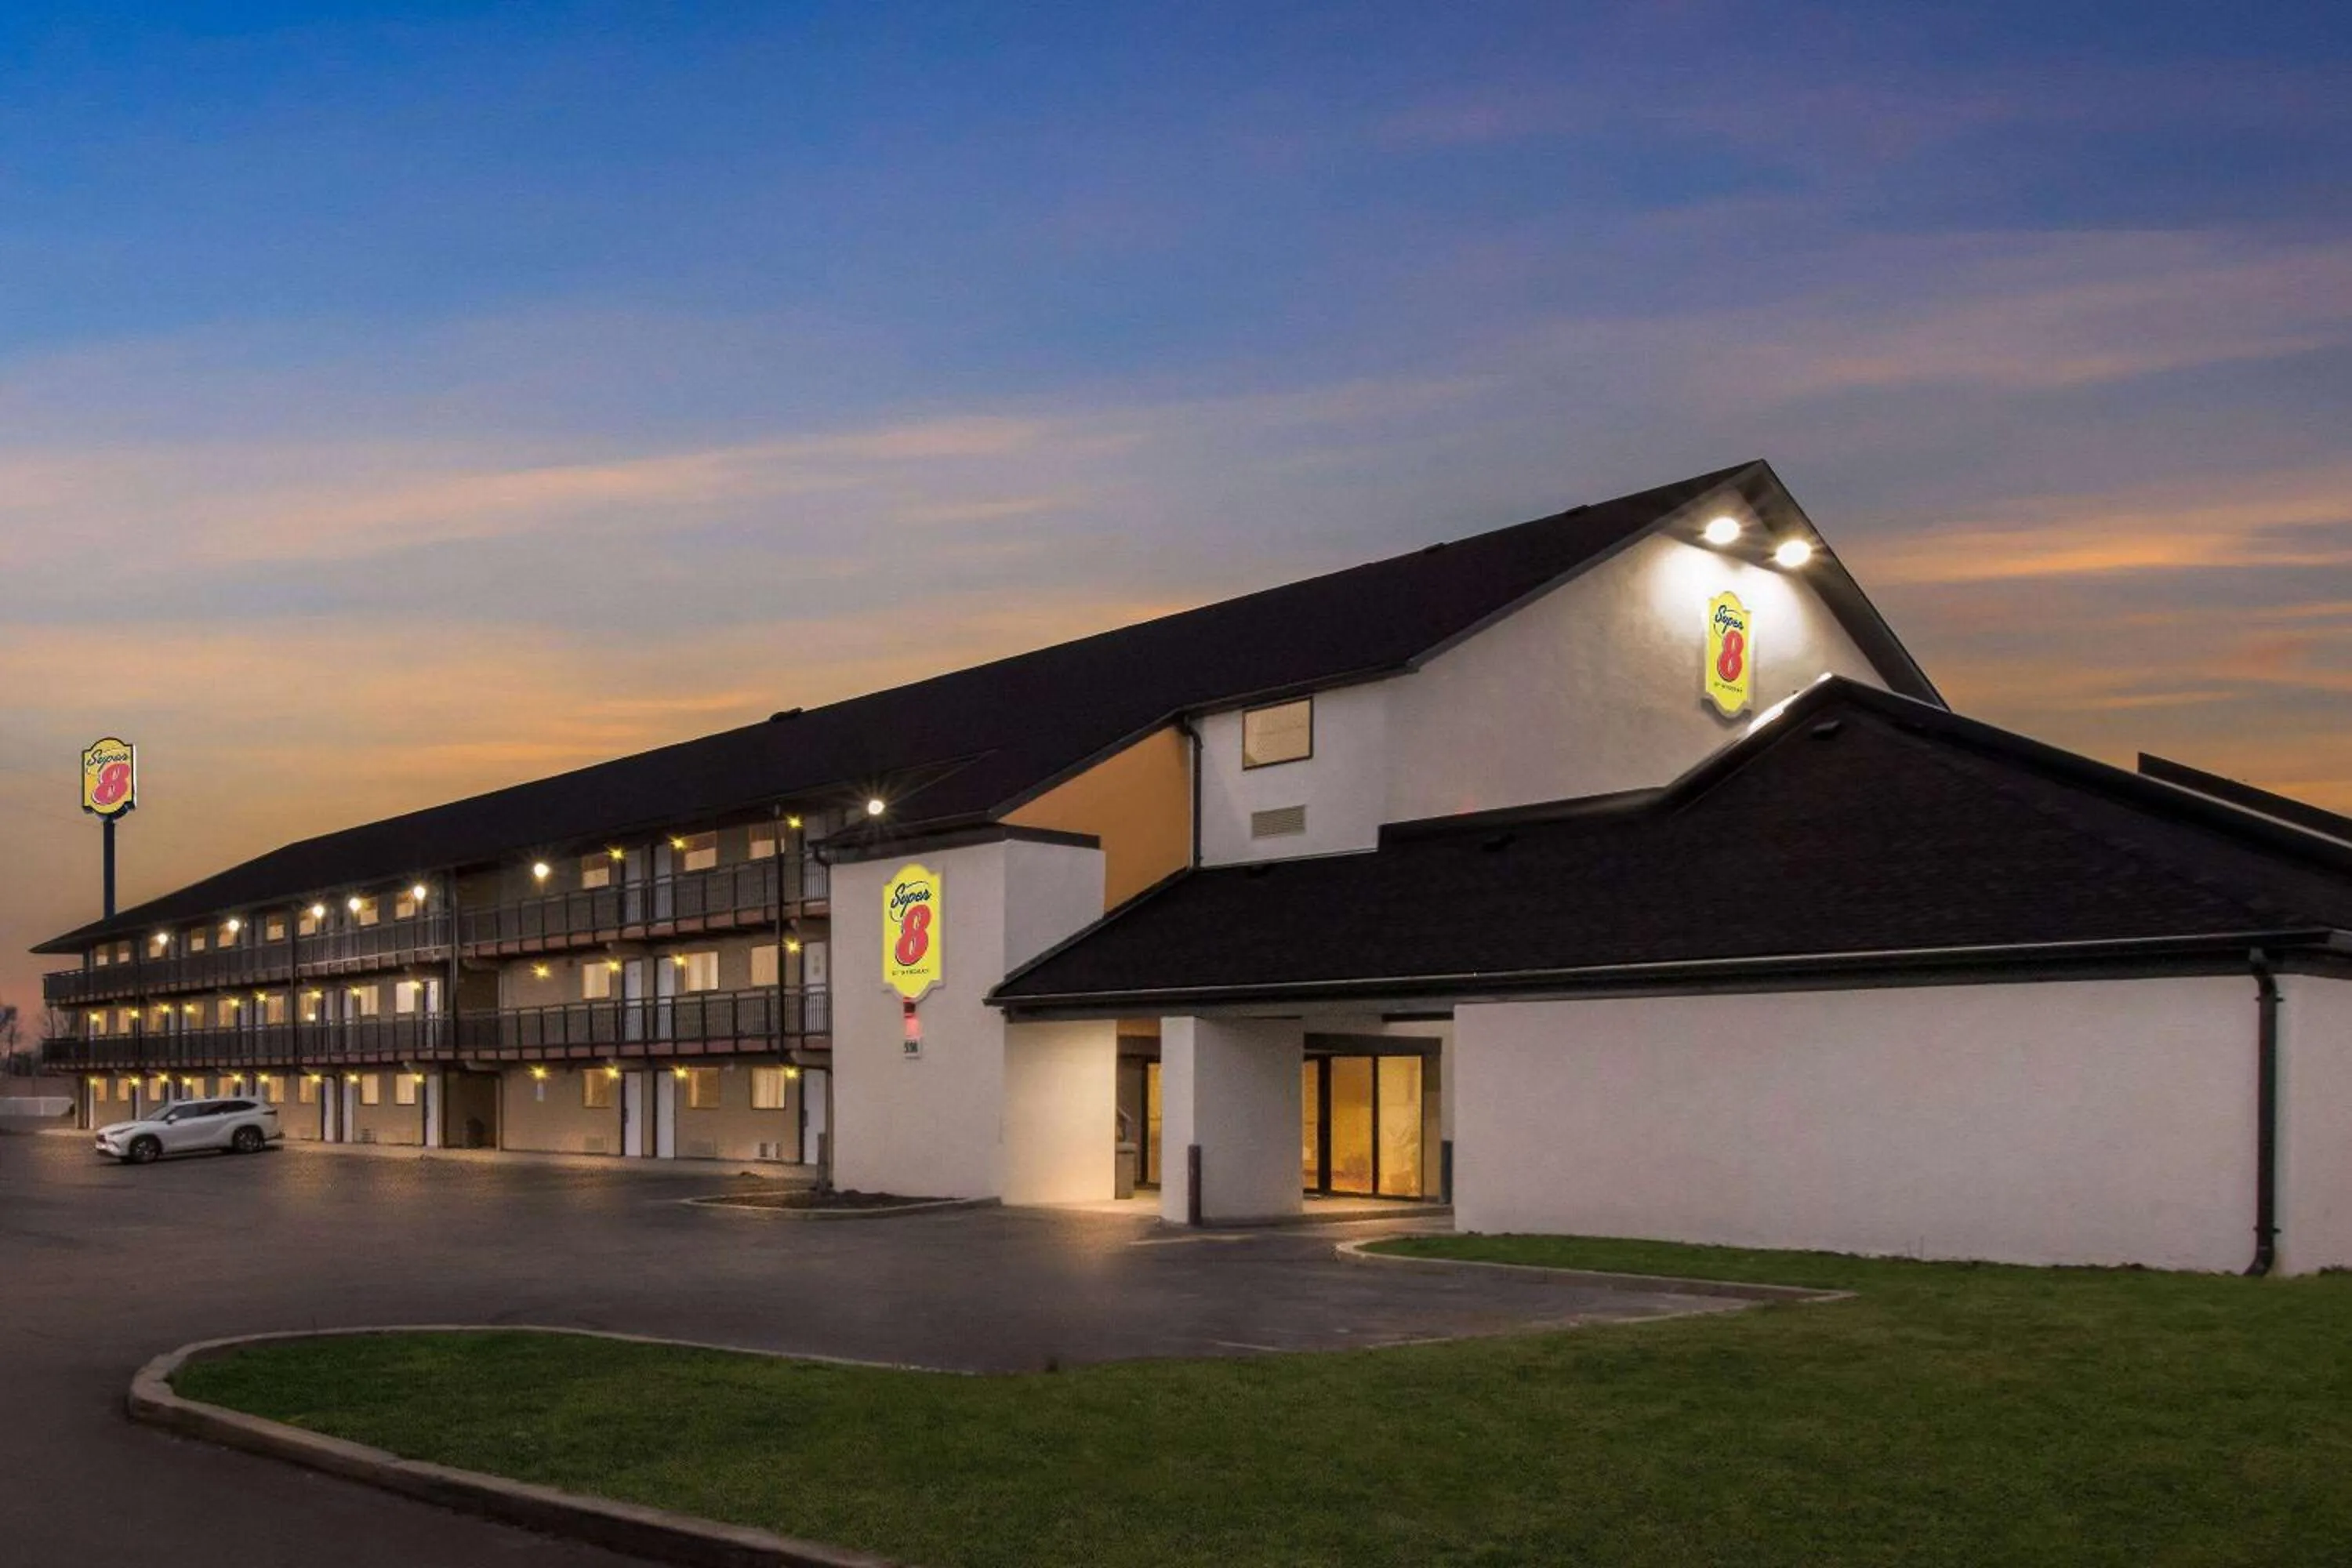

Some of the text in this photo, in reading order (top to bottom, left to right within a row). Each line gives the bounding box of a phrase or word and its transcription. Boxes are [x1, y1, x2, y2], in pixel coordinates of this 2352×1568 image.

[1714, 604, 1744, 633] Super
[1717, 630, 1744, 683] 8
[86, 749, 129, 772] Super
[91, 763, 130, 805] 8
[890, 881, 931, 920] Super
[895, 904, 932, 966] 8
